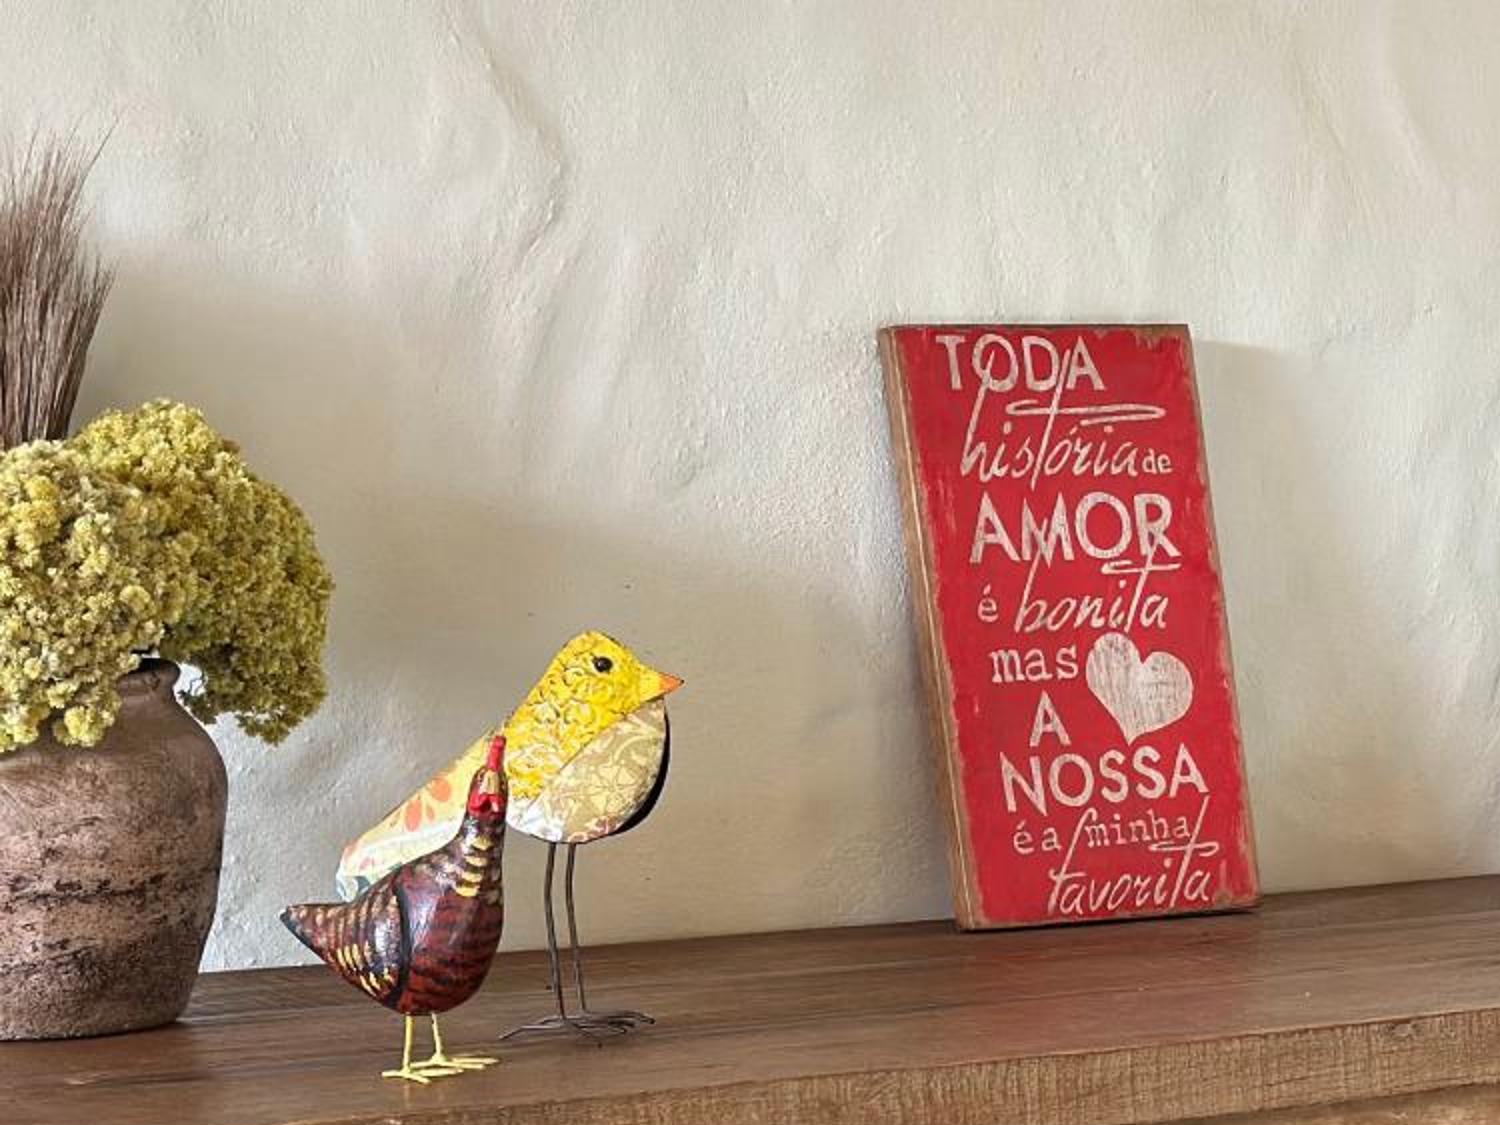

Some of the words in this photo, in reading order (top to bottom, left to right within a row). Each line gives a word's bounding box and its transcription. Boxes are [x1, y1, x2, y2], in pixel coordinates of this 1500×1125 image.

[936, 333, 1105, 392] TODA
[961, 349, 1166, 491] história
[1142, 451, 1173, 474] de
[970, 491, 1181, 566] AMOR
[977, 583, 998, 622] é
[1014, 524, 1181, 633] bonita
[990, 645, 1080, 684] mas
[1029, 691, 1072, 747] A
[1000, 743, 1210, 816] NOSSA
[1048, 795, 1219, 915] favorita
[1085, 810, 1191, 848] minha
